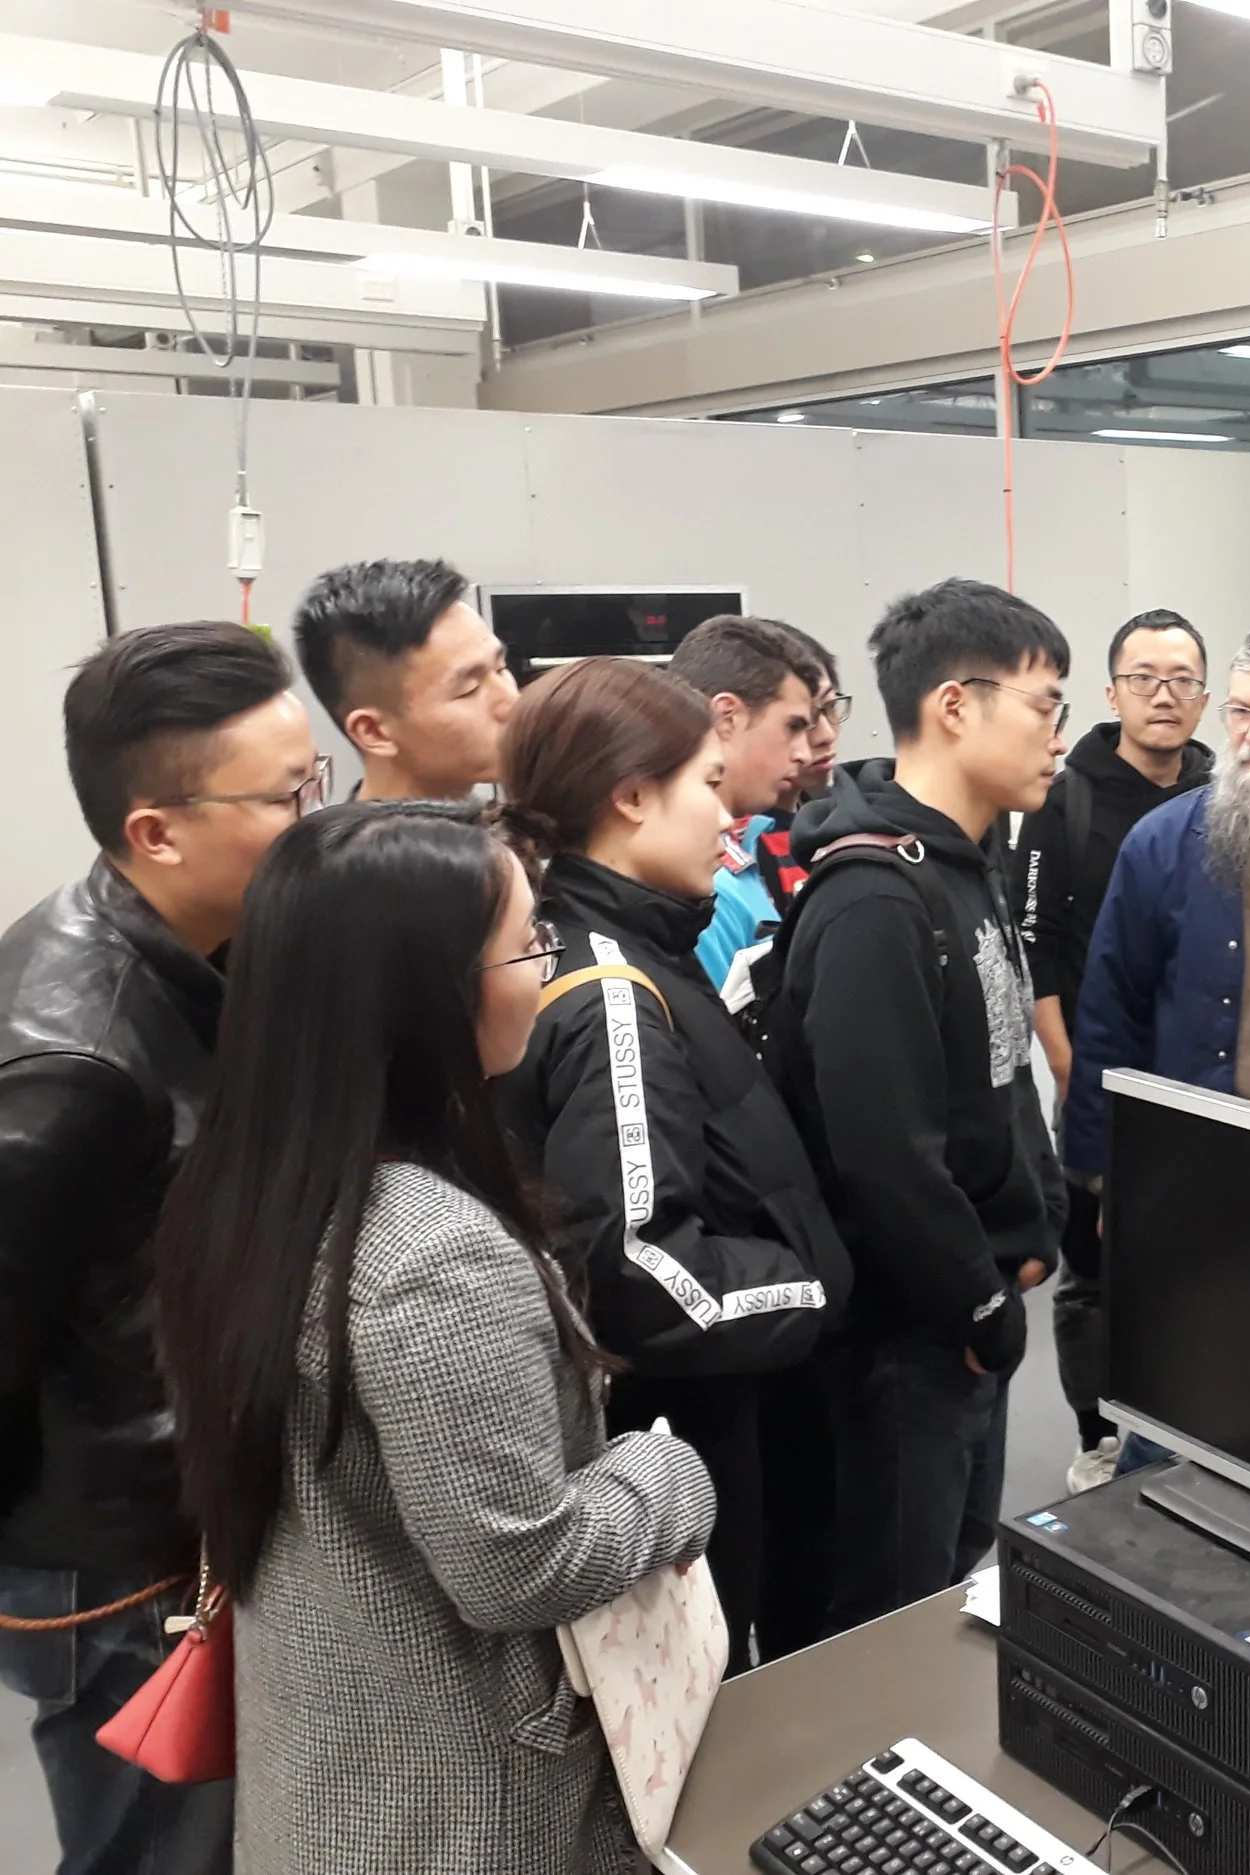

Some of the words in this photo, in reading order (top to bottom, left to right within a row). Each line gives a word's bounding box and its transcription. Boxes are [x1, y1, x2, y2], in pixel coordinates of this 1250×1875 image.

[612, 1018, 641, 1109] STUSSY
[626, 1160, 651, 1223] USSY
[664, 1270, 719, 1327] TUSSY
[734, 1286, 792, 1314] STUSSY
